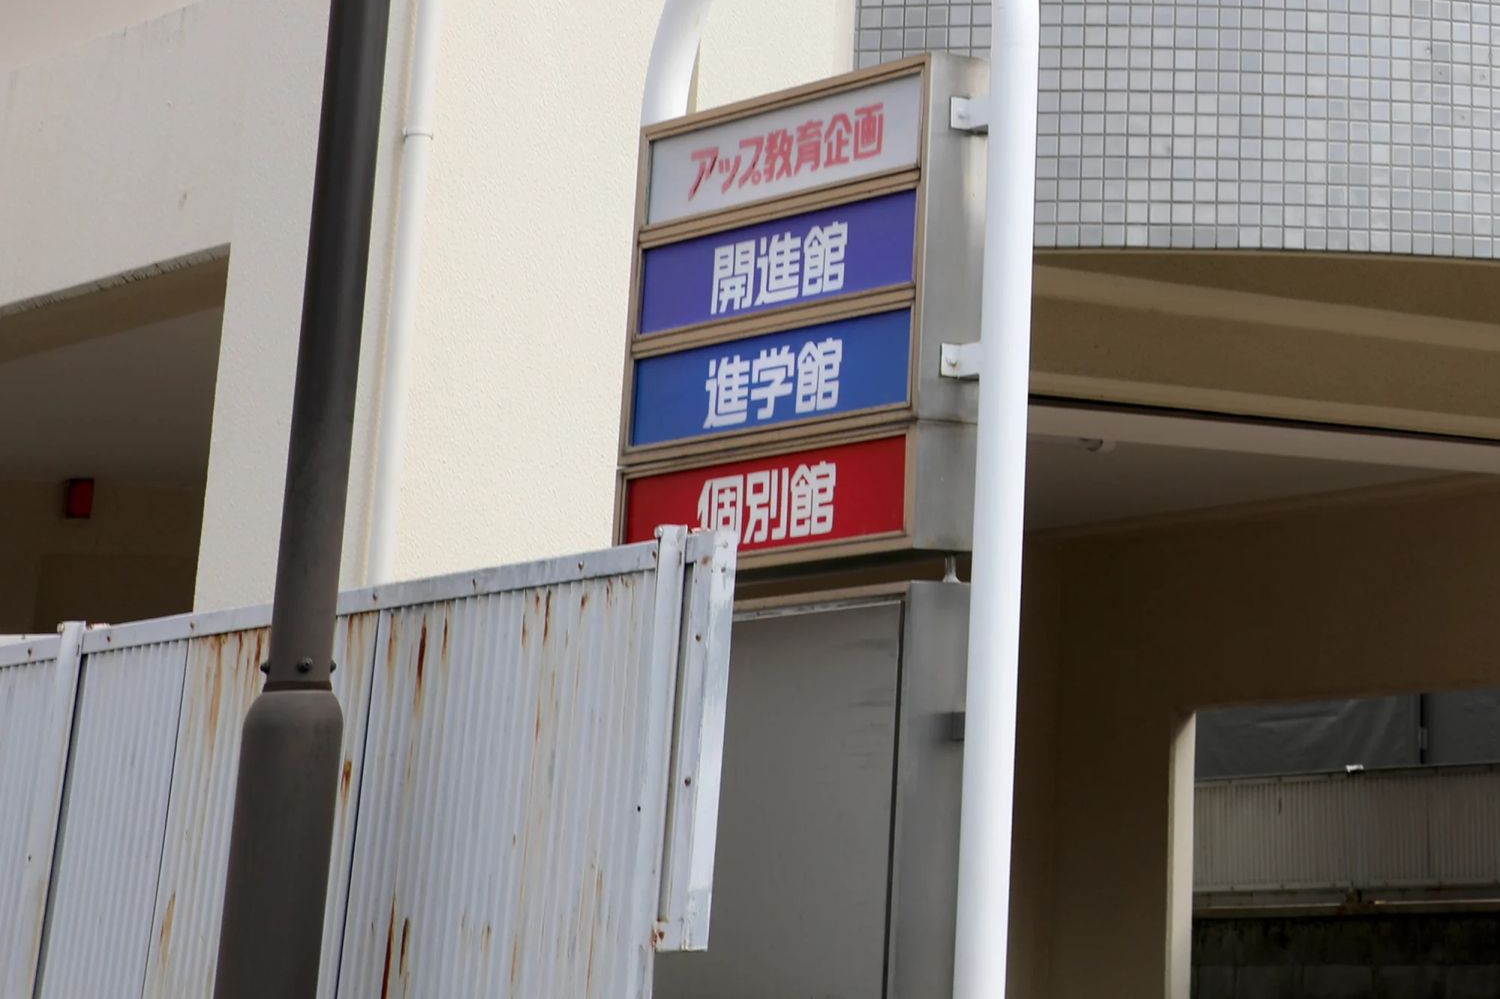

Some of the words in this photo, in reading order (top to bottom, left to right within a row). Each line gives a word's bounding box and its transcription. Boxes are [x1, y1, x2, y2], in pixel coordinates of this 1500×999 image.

[688, 101, 885, 202] アップ教育企画
[710, 221, 848, 315] 開進館
[703, 337, 843, 430] 進学館
[697, 462, 836, 543] 個別館
